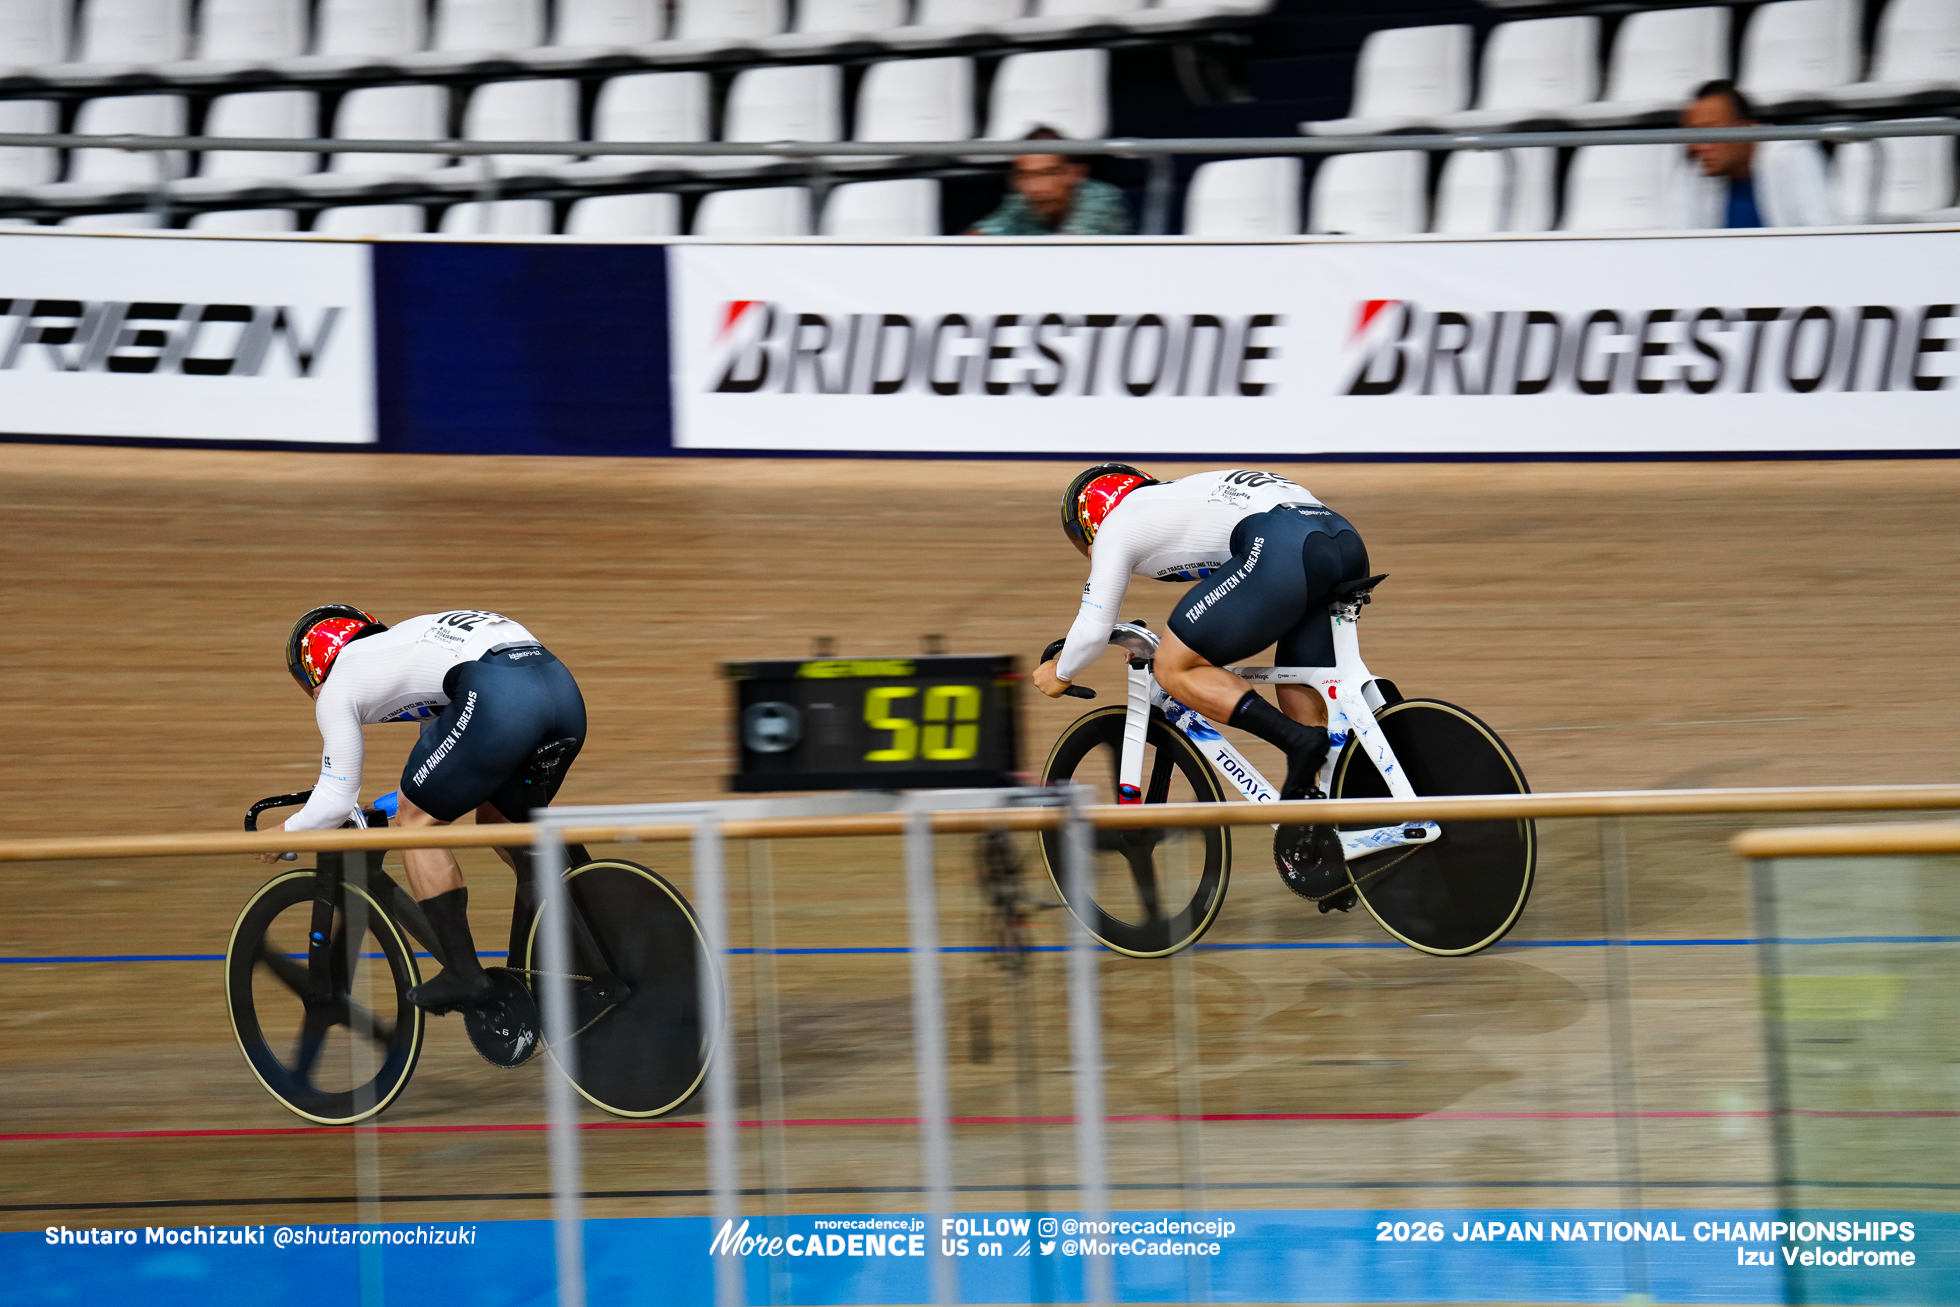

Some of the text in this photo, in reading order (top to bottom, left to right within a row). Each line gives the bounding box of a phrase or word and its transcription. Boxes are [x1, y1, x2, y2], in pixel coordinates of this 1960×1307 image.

[0, 298, 345, 378] RIGON
[706, 300, 1287, 397] BRIDGESTONE
[1340, 299, 1960, 396] BRIDGESTONE
[1102, 477, 1134, 517] JAPAN
[1167, 565, 1184, 573] TRACK
[1184, 562, 1206, 570] CYCLING
[1185, 536, 1265, 624] TEAM RAKUTEN K DREAMS
[324, 622, 356, 663] JAPAN
[388, 708, 403, 718] TRACK
[403, 701, 424, 711] CYCLING
[413, 690, 477, 787] TEAM RAKUTEN K DREAMS
[863, 685, 981, 762] 50
